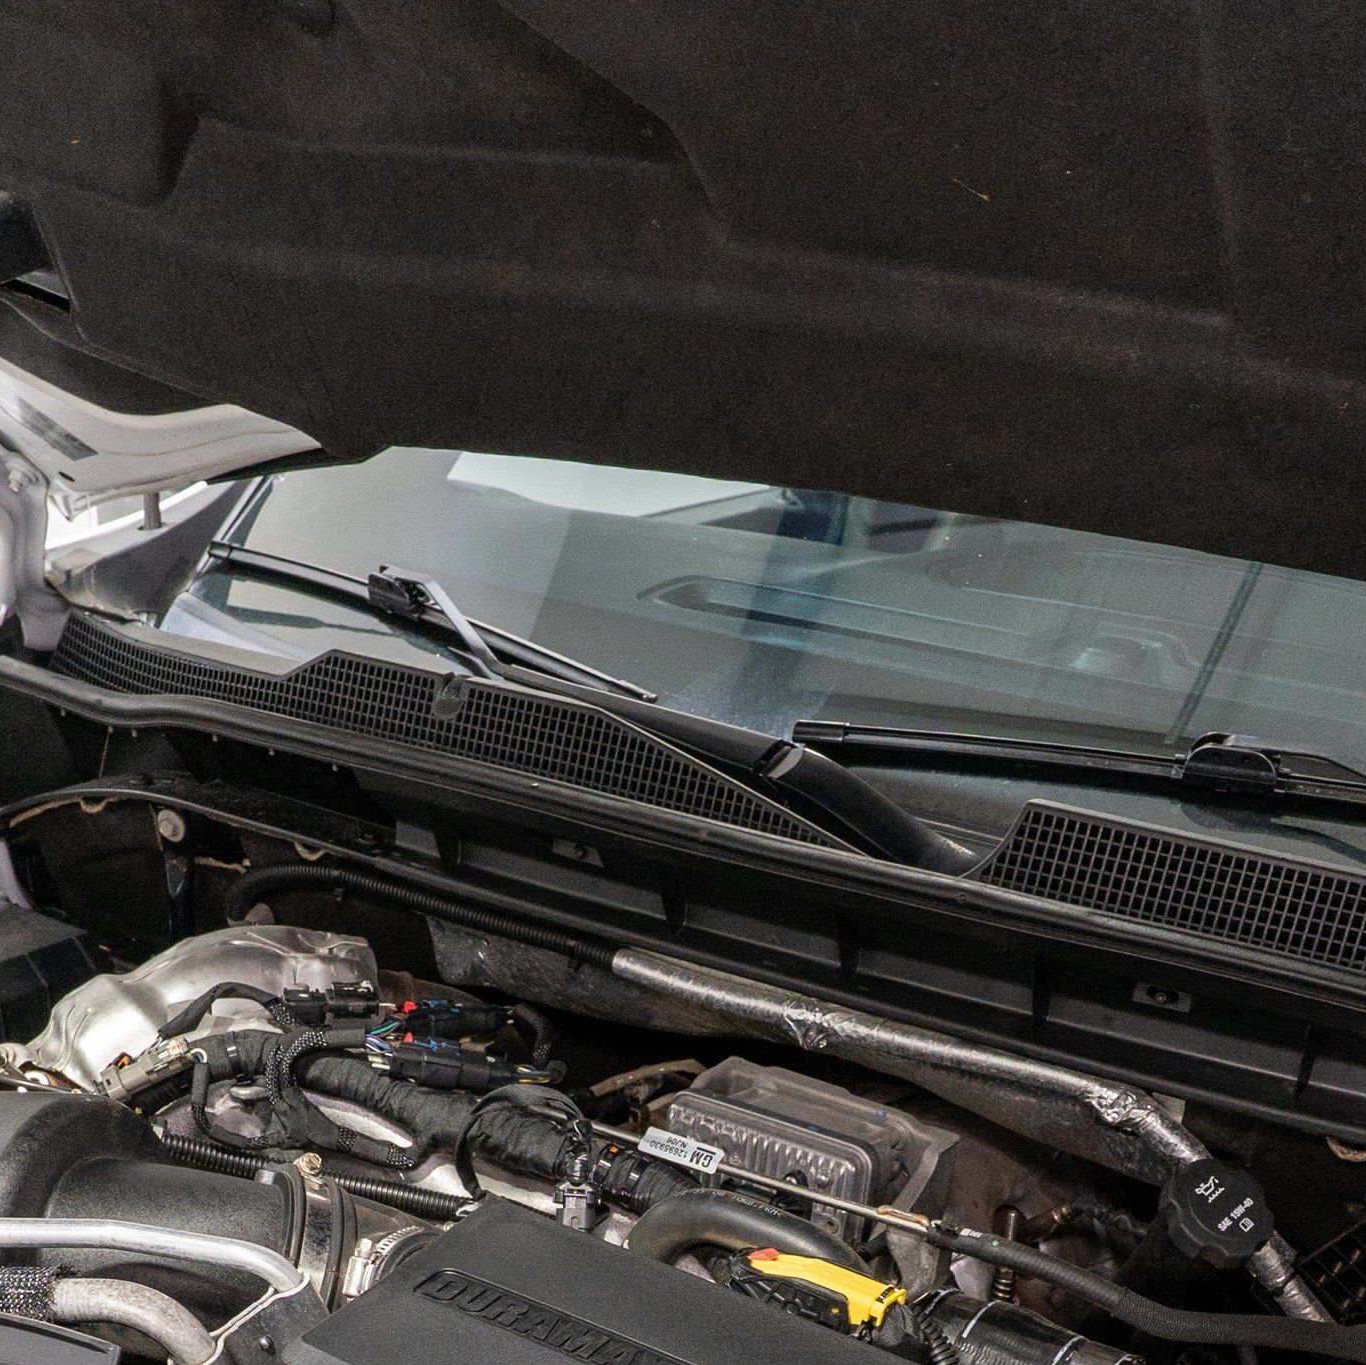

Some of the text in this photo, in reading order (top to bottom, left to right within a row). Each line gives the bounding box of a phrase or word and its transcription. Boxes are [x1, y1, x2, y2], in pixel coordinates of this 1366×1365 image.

[690, 1150, 714, 1168] GM
[1218, 1198, 1253, 1231] SAE 15W-40
